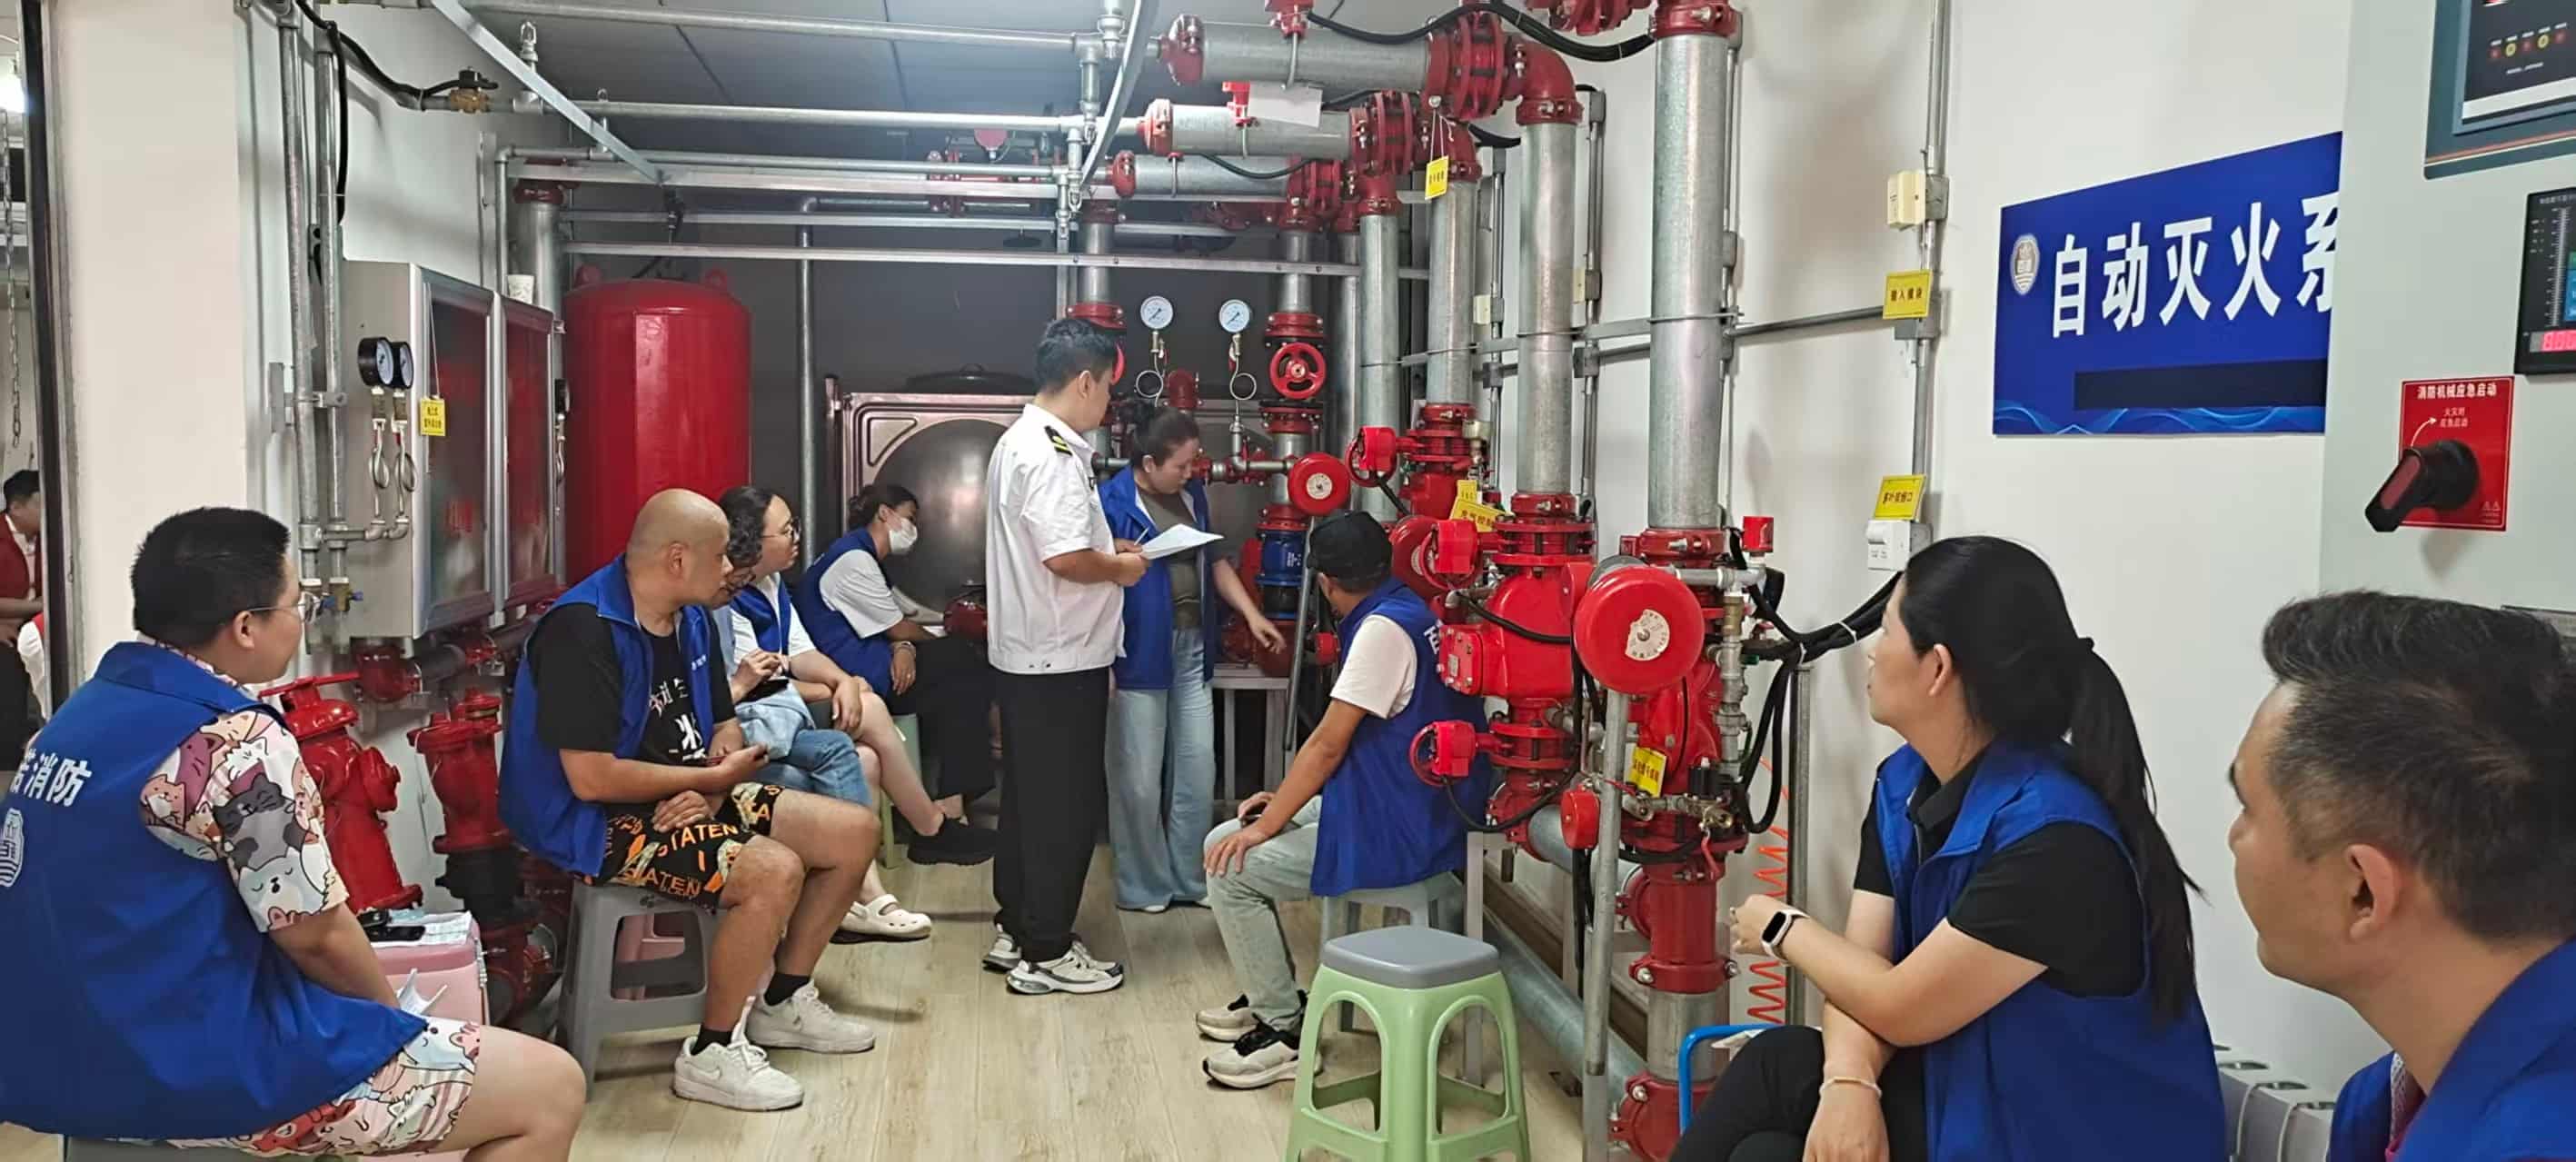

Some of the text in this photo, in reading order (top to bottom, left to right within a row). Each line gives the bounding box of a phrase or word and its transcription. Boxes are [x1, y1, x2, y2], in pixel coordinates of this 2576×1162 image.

[2053, 192, 2339, 339] 自动灭火系
